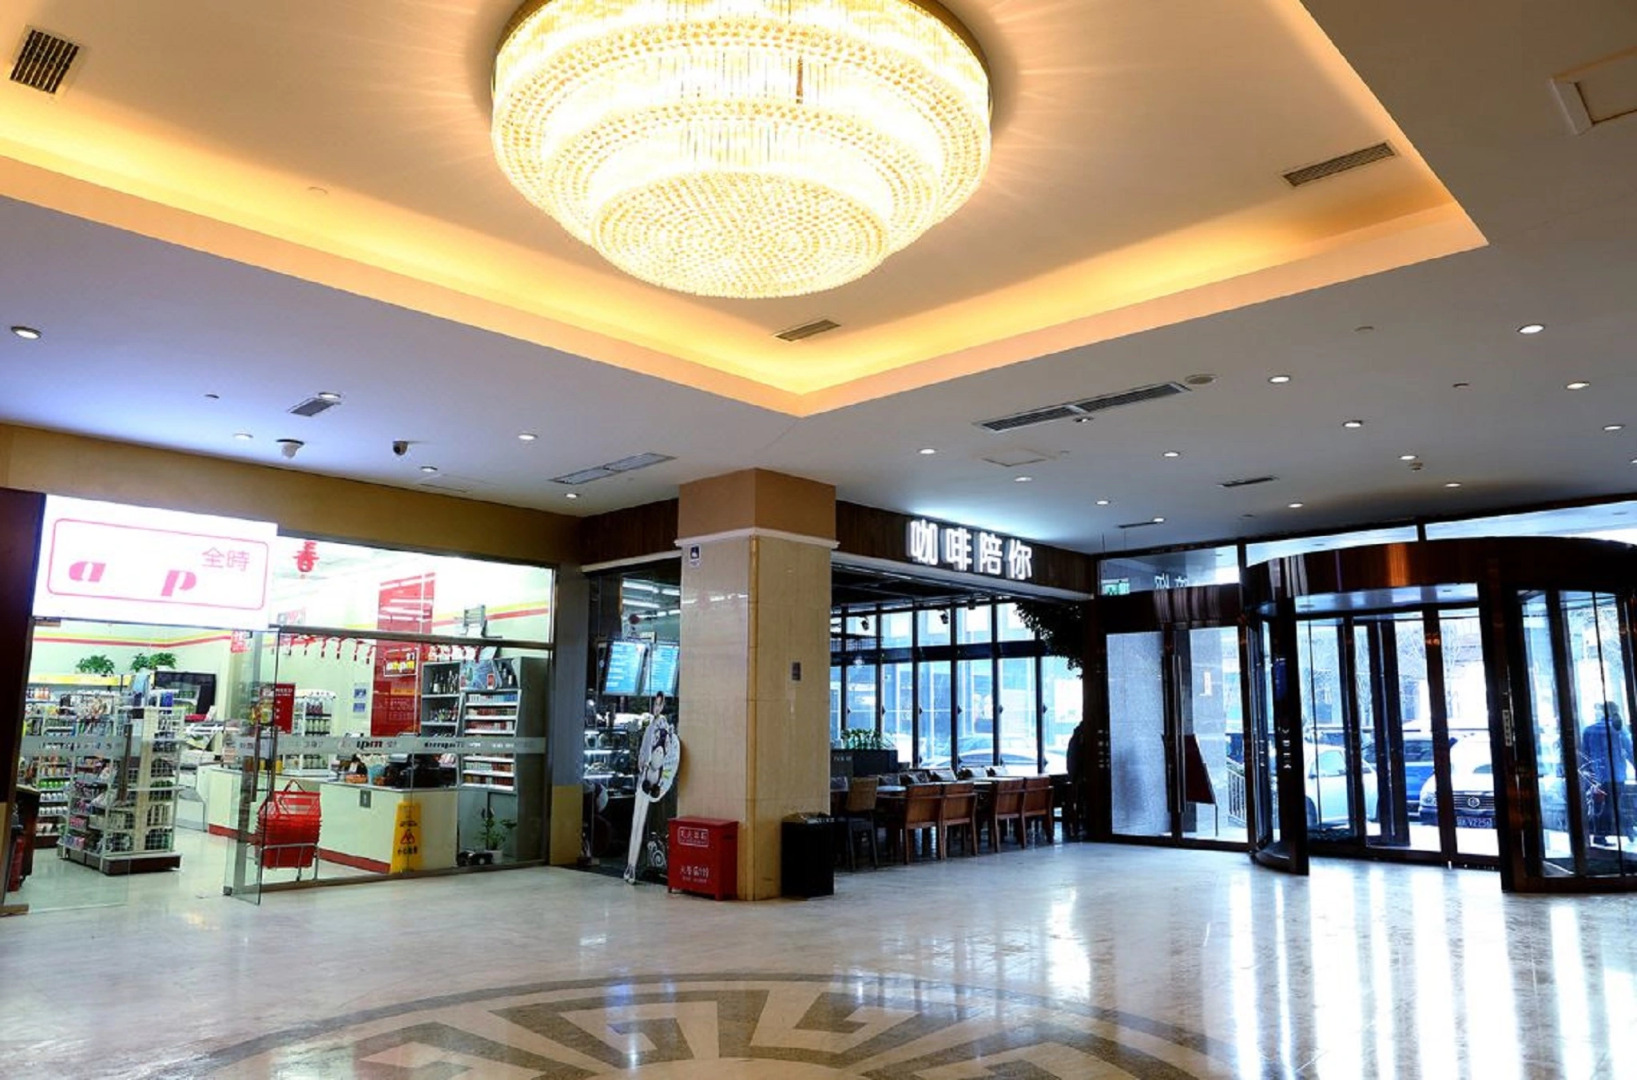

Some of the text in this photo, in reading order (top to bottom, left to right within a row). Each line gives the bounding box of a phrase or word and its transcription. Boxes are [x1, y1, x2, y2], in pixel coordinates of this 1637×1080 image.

[201, 546, 251, 572] 全時
[906, 518, 1031, 580] 咖啡陪你
